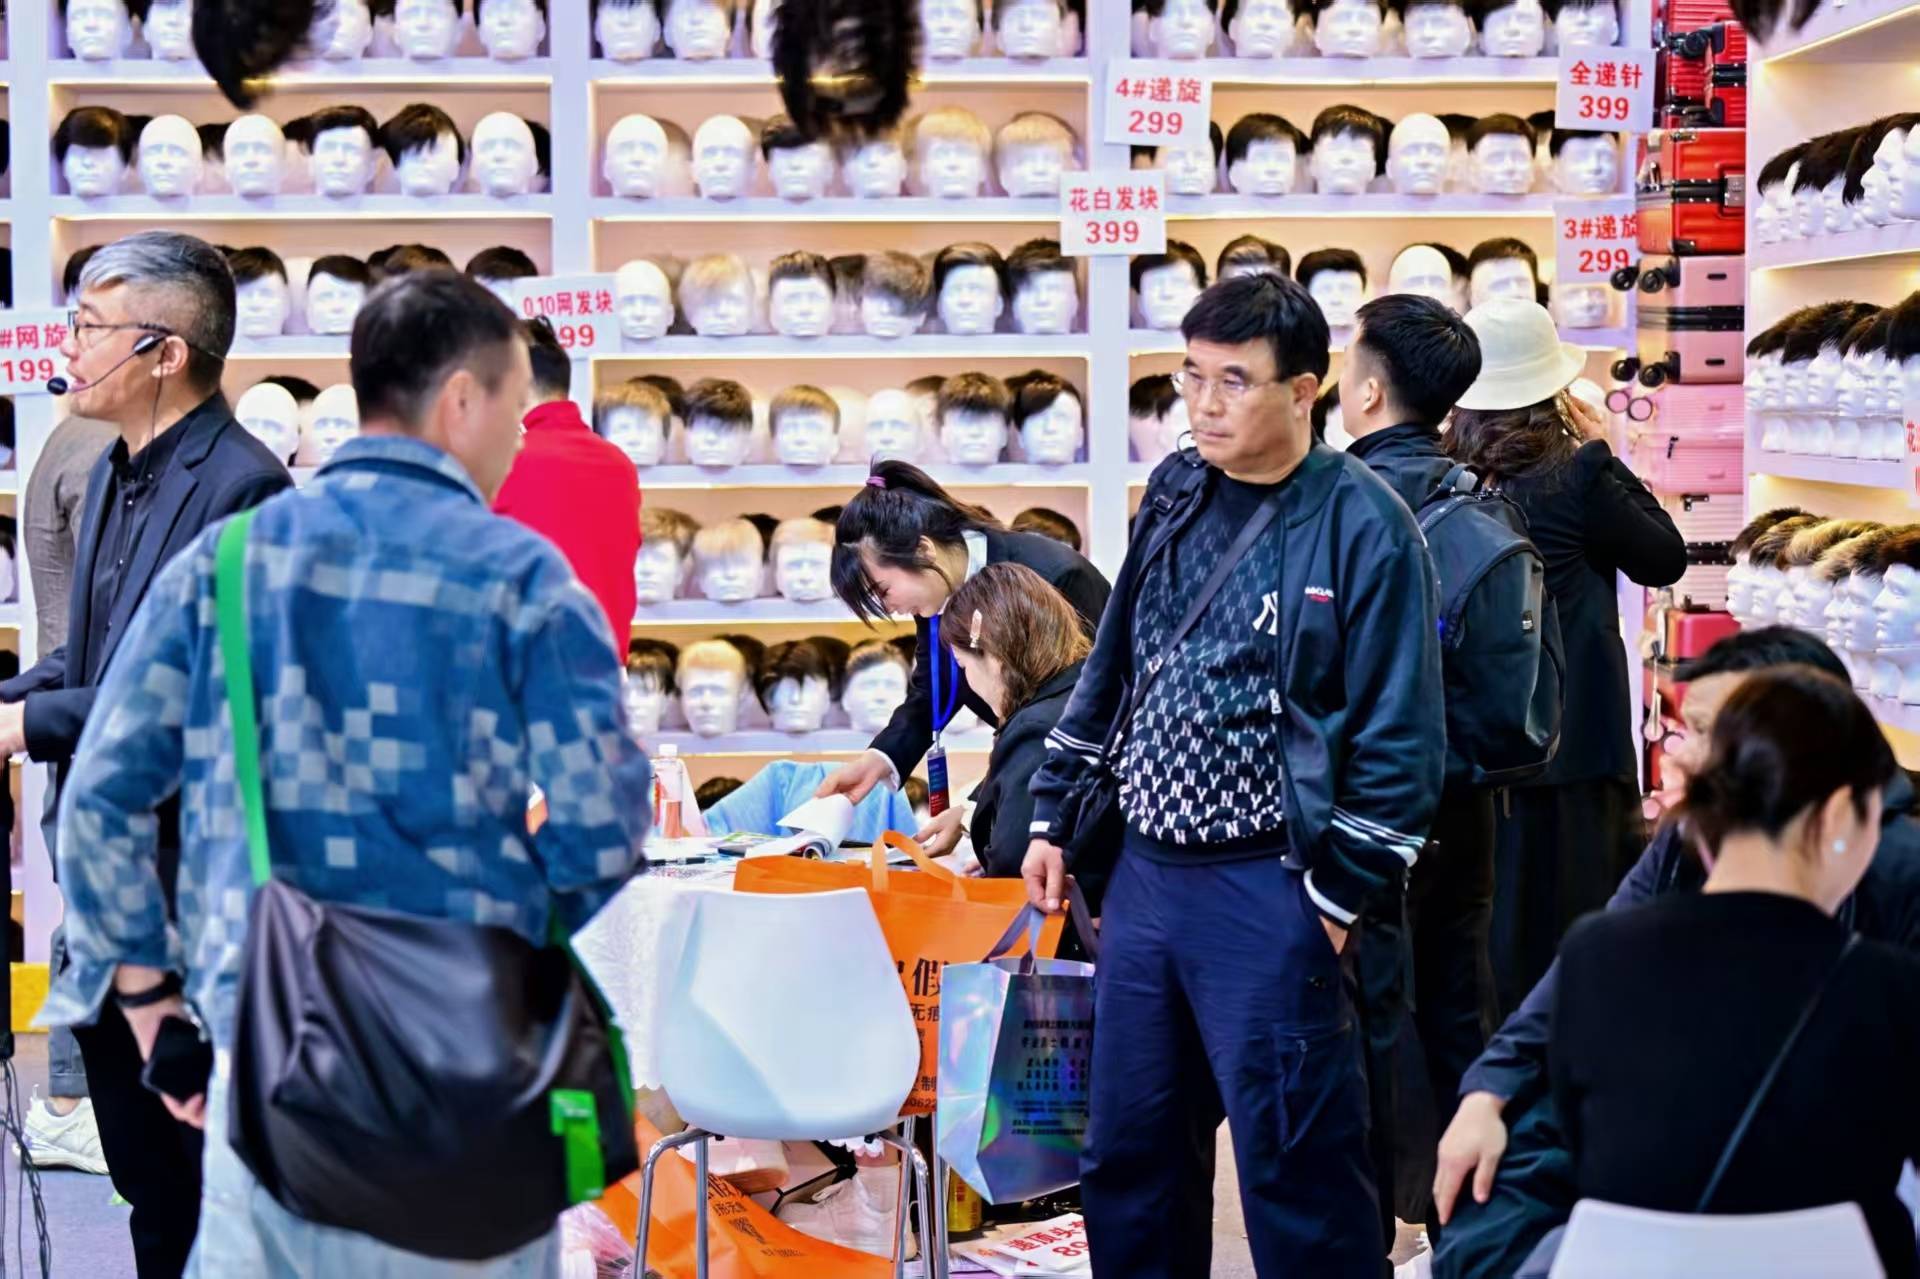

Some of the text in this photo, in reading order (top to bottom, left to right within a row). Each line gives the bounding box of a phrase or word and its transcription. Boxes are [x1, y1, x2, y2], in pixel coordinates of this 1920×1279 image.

[1570, 60, 1643, 90] 全递针
[1116, 78, 1201, 103] 4#递旋
[1579, 95, 1628, 119] 399
[1128, 110, 1183, 135] 299
[1069, 187, 1159, 212] 花白发块
[1086, 221, 1139, 244] 399
[1579, 248, 1629, 272] 299
[557, 324, 594, 348] 99
[1, 359, 54, 383] 199
